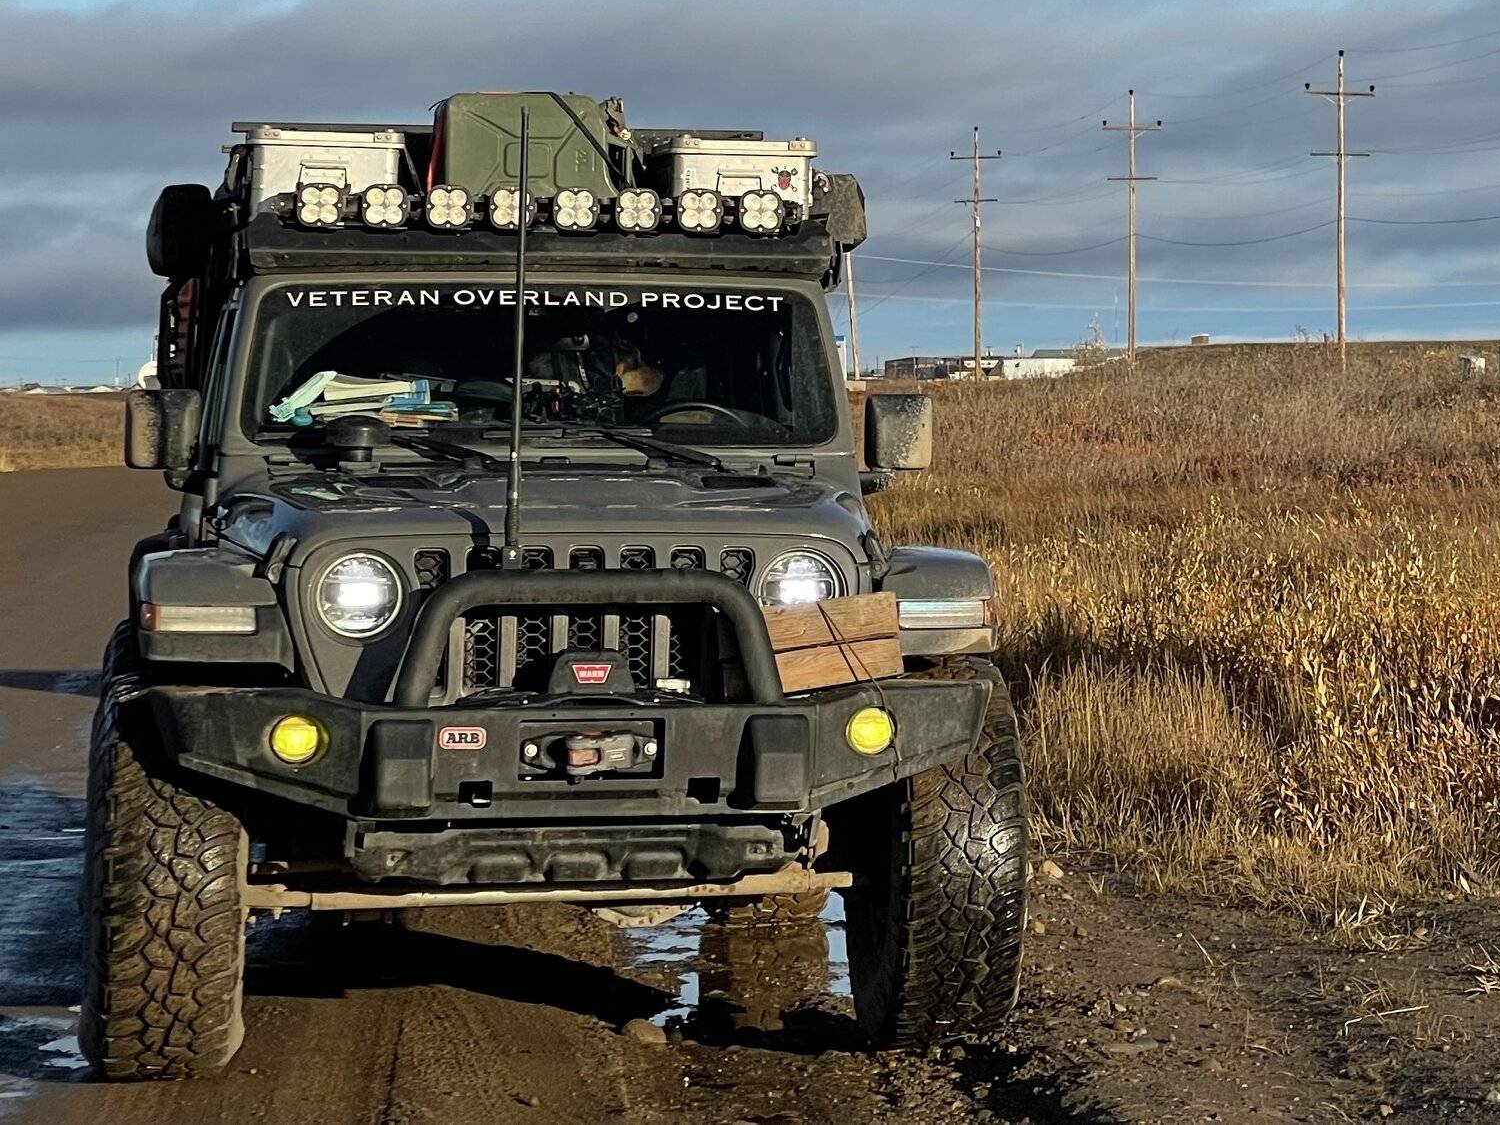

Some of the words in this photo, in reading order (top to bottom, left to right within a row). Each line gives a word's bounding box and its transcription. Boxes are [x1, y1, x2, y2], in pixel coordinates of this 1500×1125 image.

[286, 290, 440, 307] VETERAN
[453, 290, 629, 307] OVERLAND
[641, 292, 784, 312] PROJECT
[446, 732, 481, 744] ARB
